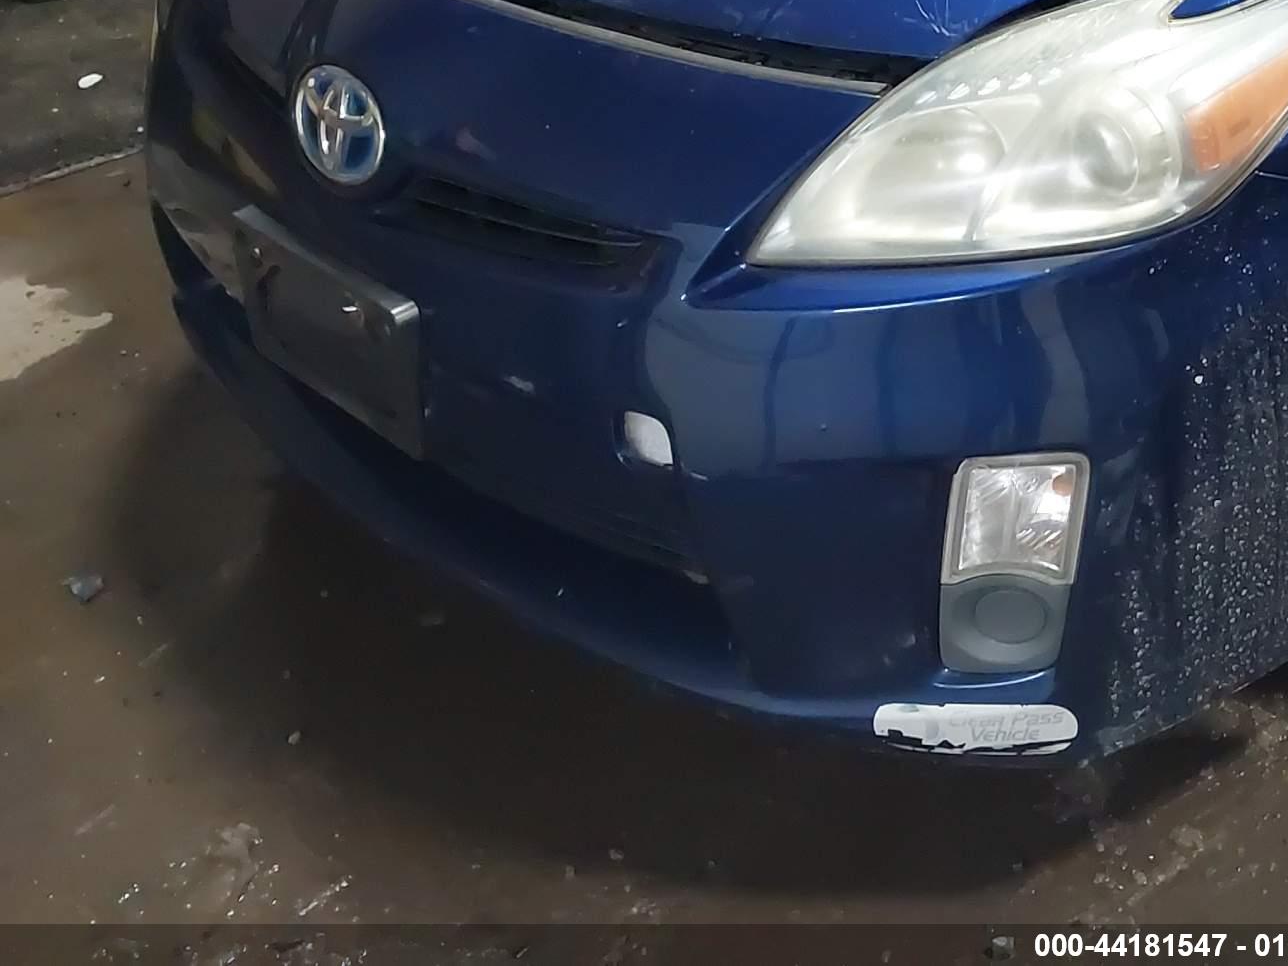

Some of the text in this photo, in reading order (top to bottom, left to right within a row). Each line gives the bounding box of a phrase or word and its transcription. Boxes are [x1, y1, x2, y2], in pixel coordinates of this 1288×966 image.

[950, 710, 1065, 728] Clean Pass
[970, 726, 1041, 743] Vehicle
